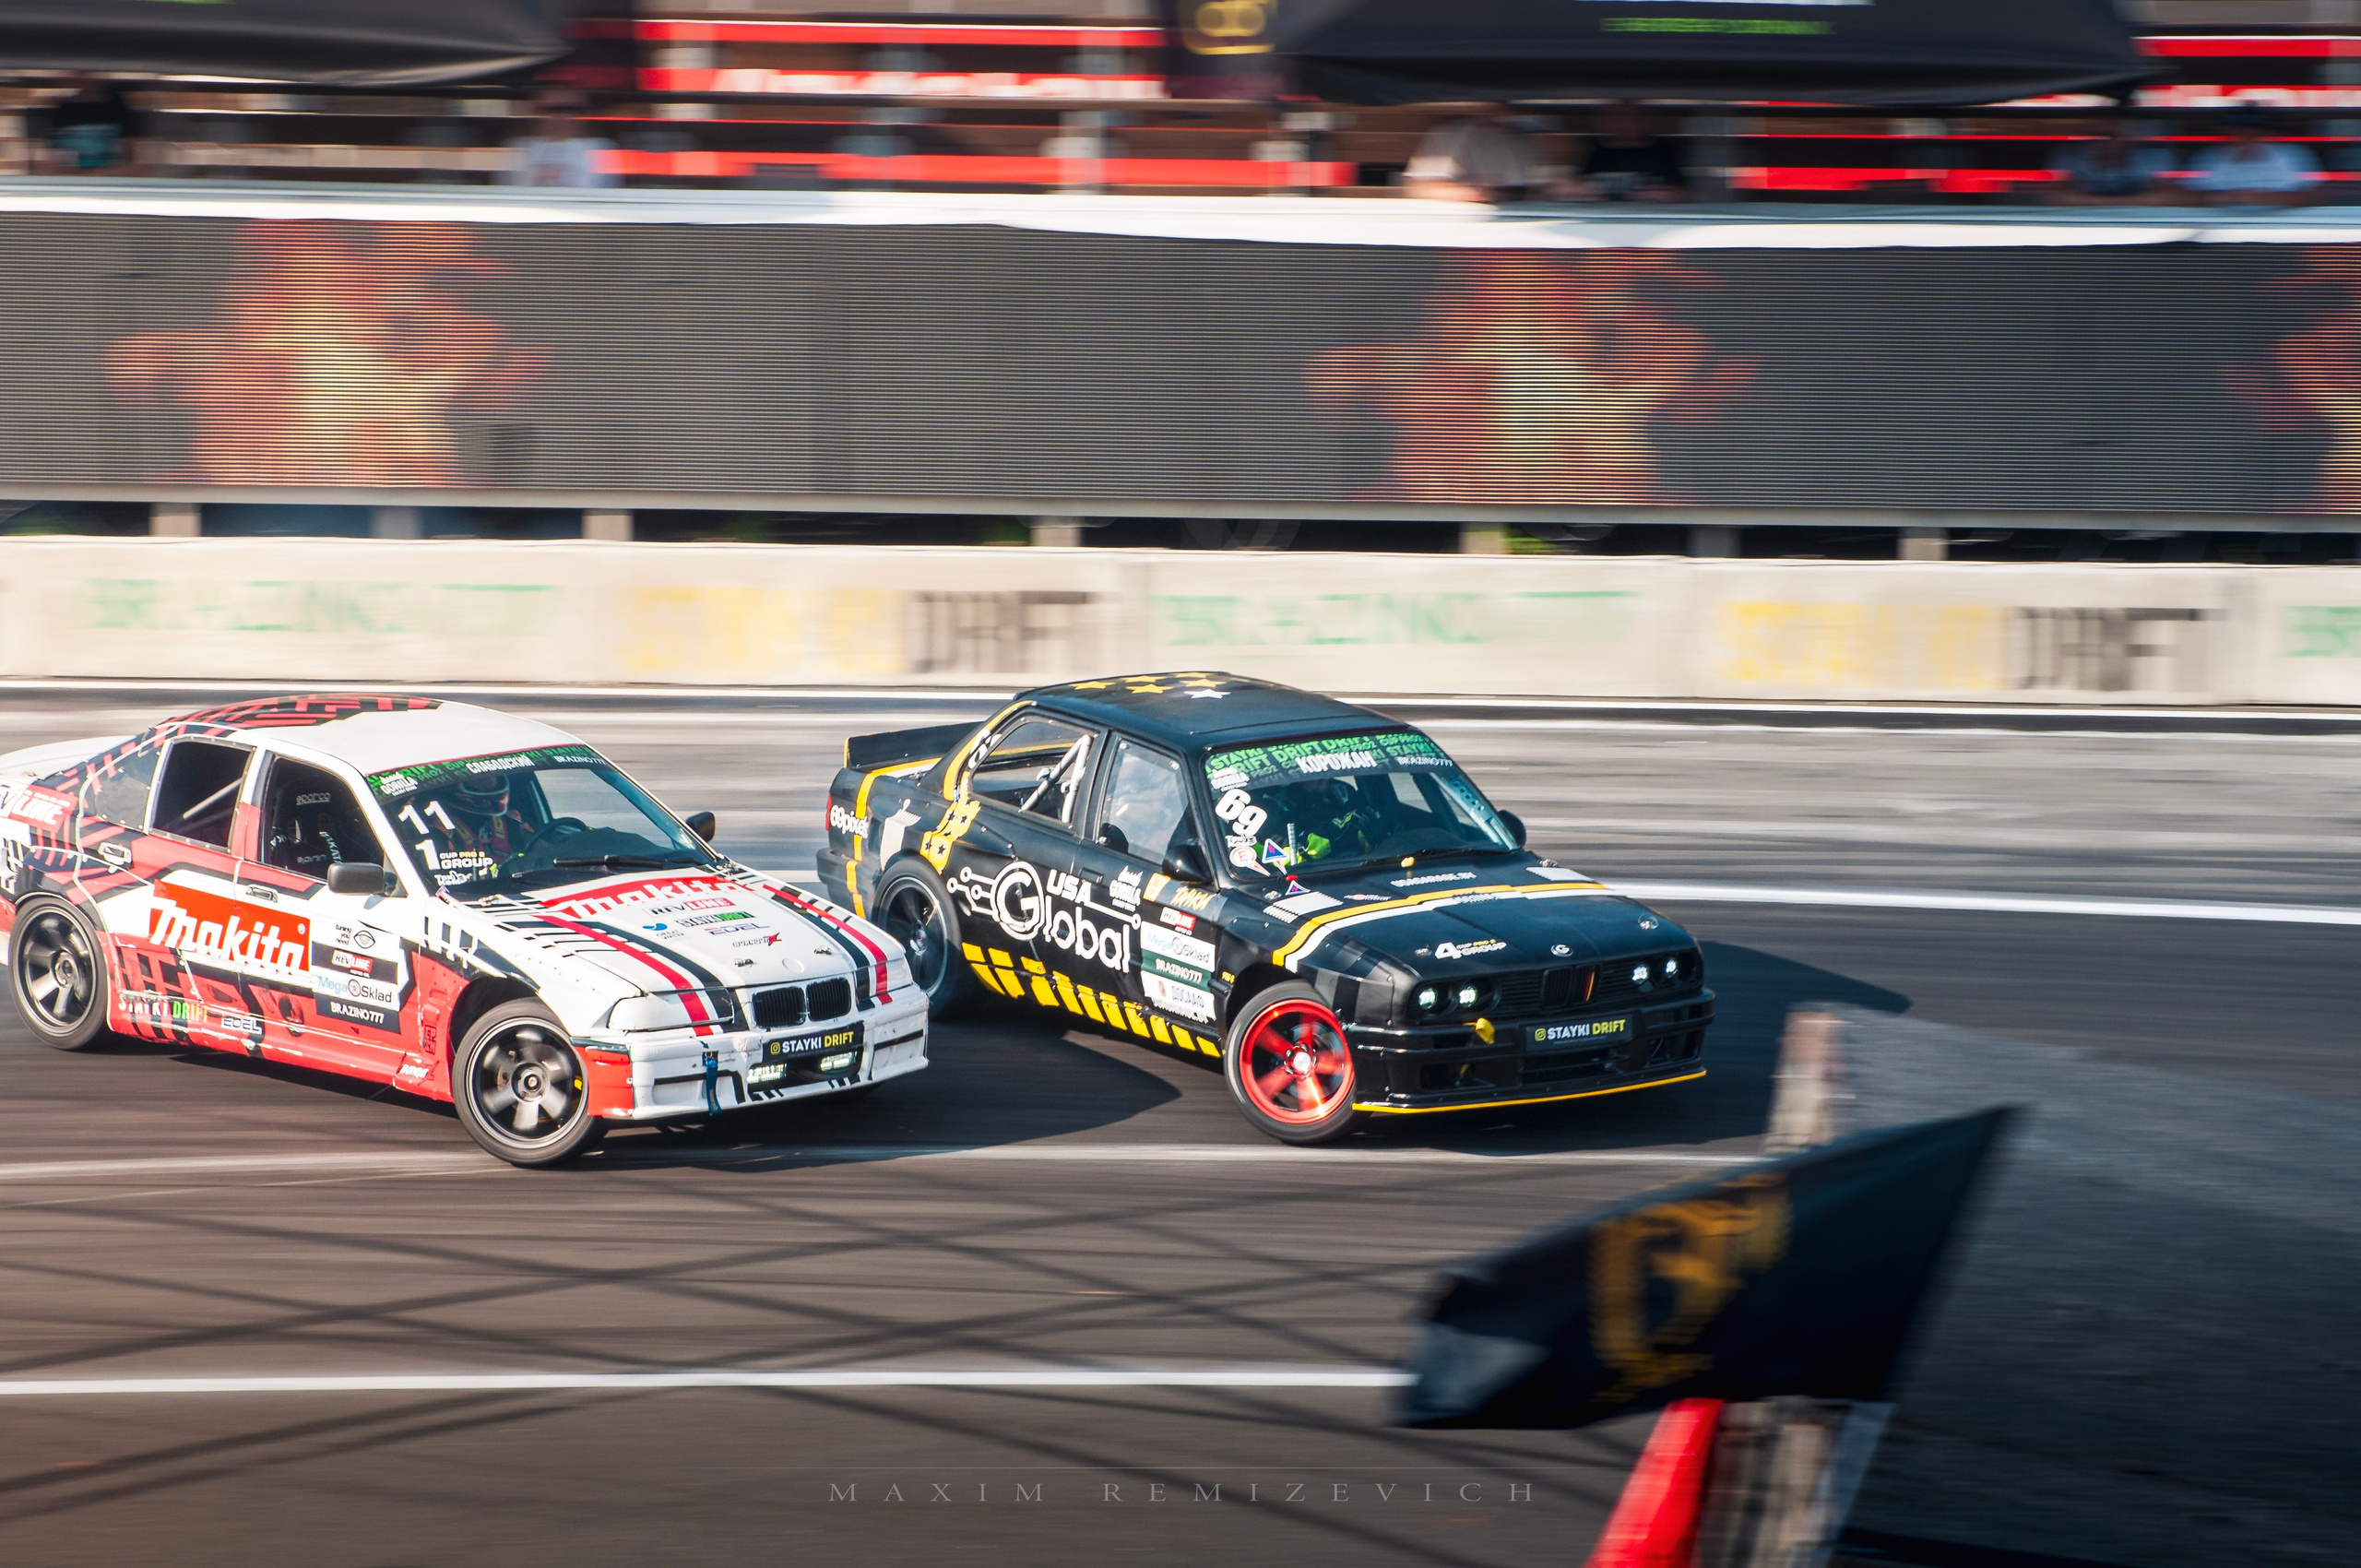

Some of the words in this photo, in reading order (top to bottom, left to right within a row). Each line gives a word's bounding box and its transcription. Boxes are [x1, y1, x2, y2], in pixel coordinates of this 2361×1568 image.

[466, 754, 535, 774] СЛАБОДСКИЙ
[1295, 751, 1378, 774] КОРОЖАН
[397, 800, 456, 835] 11
[1215, 788, 1268, 837] 69
[415, 838, 441, 871] 1
[439, 851, 458, 860] CUP
[458, 850, 478, 859] PRO
[441, 858, 493, 869] GROUP
[1046, 869, 1096, 905] USA
[996, 870, 1130, 973] Global
[1434, 942, 1462, 960] 4
[1461, 942, 1507, 956] GROUP
[318, 976, 348, 994] Mega
[361, 985, 392, 1004] Sklad
[172, 1001, 208, 1023] DRIFT
[330, 1002, 385, 1024] BRAZINO777
[223, 1016, 262, 1032] EDEL
[1547, 1023, 1590, 1040] STAYKI
[1592, 1019, 1625, 1035] DRIFT
[782, 1036, 822, 1053] STAYKI
[824, 1030, 854, 1048] DRIFT
